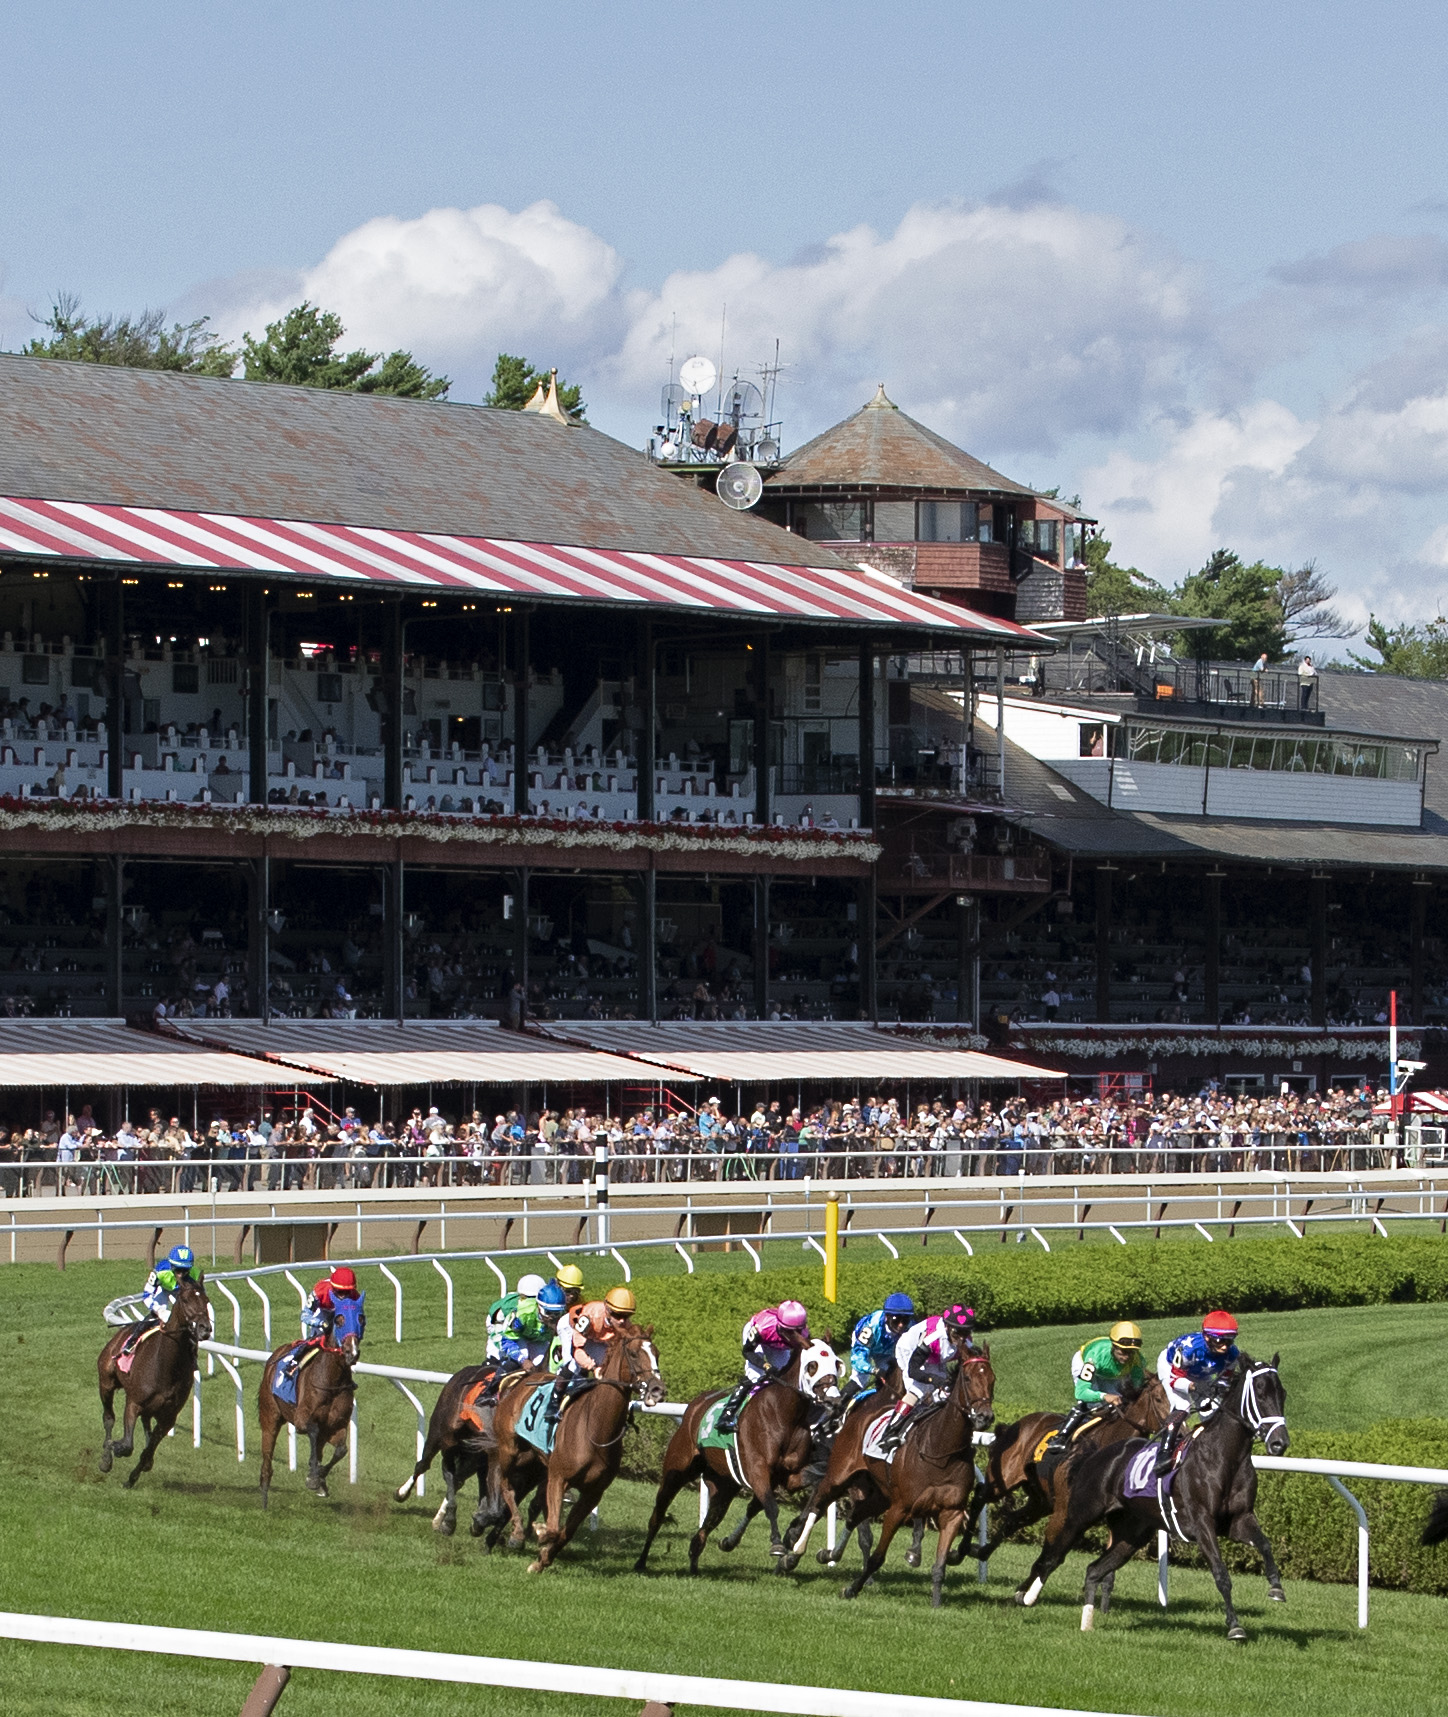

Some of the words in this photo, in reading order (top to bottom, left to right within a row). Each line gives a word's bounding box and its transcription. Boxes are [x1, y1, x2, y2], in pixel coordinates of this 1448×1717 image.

[178, 1249, 188, 1259] W
[148, 1271, 156, 1285] 8
[574, 1315, 590, 1333] 9
[858, 1327, 872, 1345] 2
[1080, 1363, 1095, 1381] 6
[524, 1393, 544, 1431] 9
[701, 1402, 726, 1439] 5
[1129, 1446, 1158, 1489] 10
